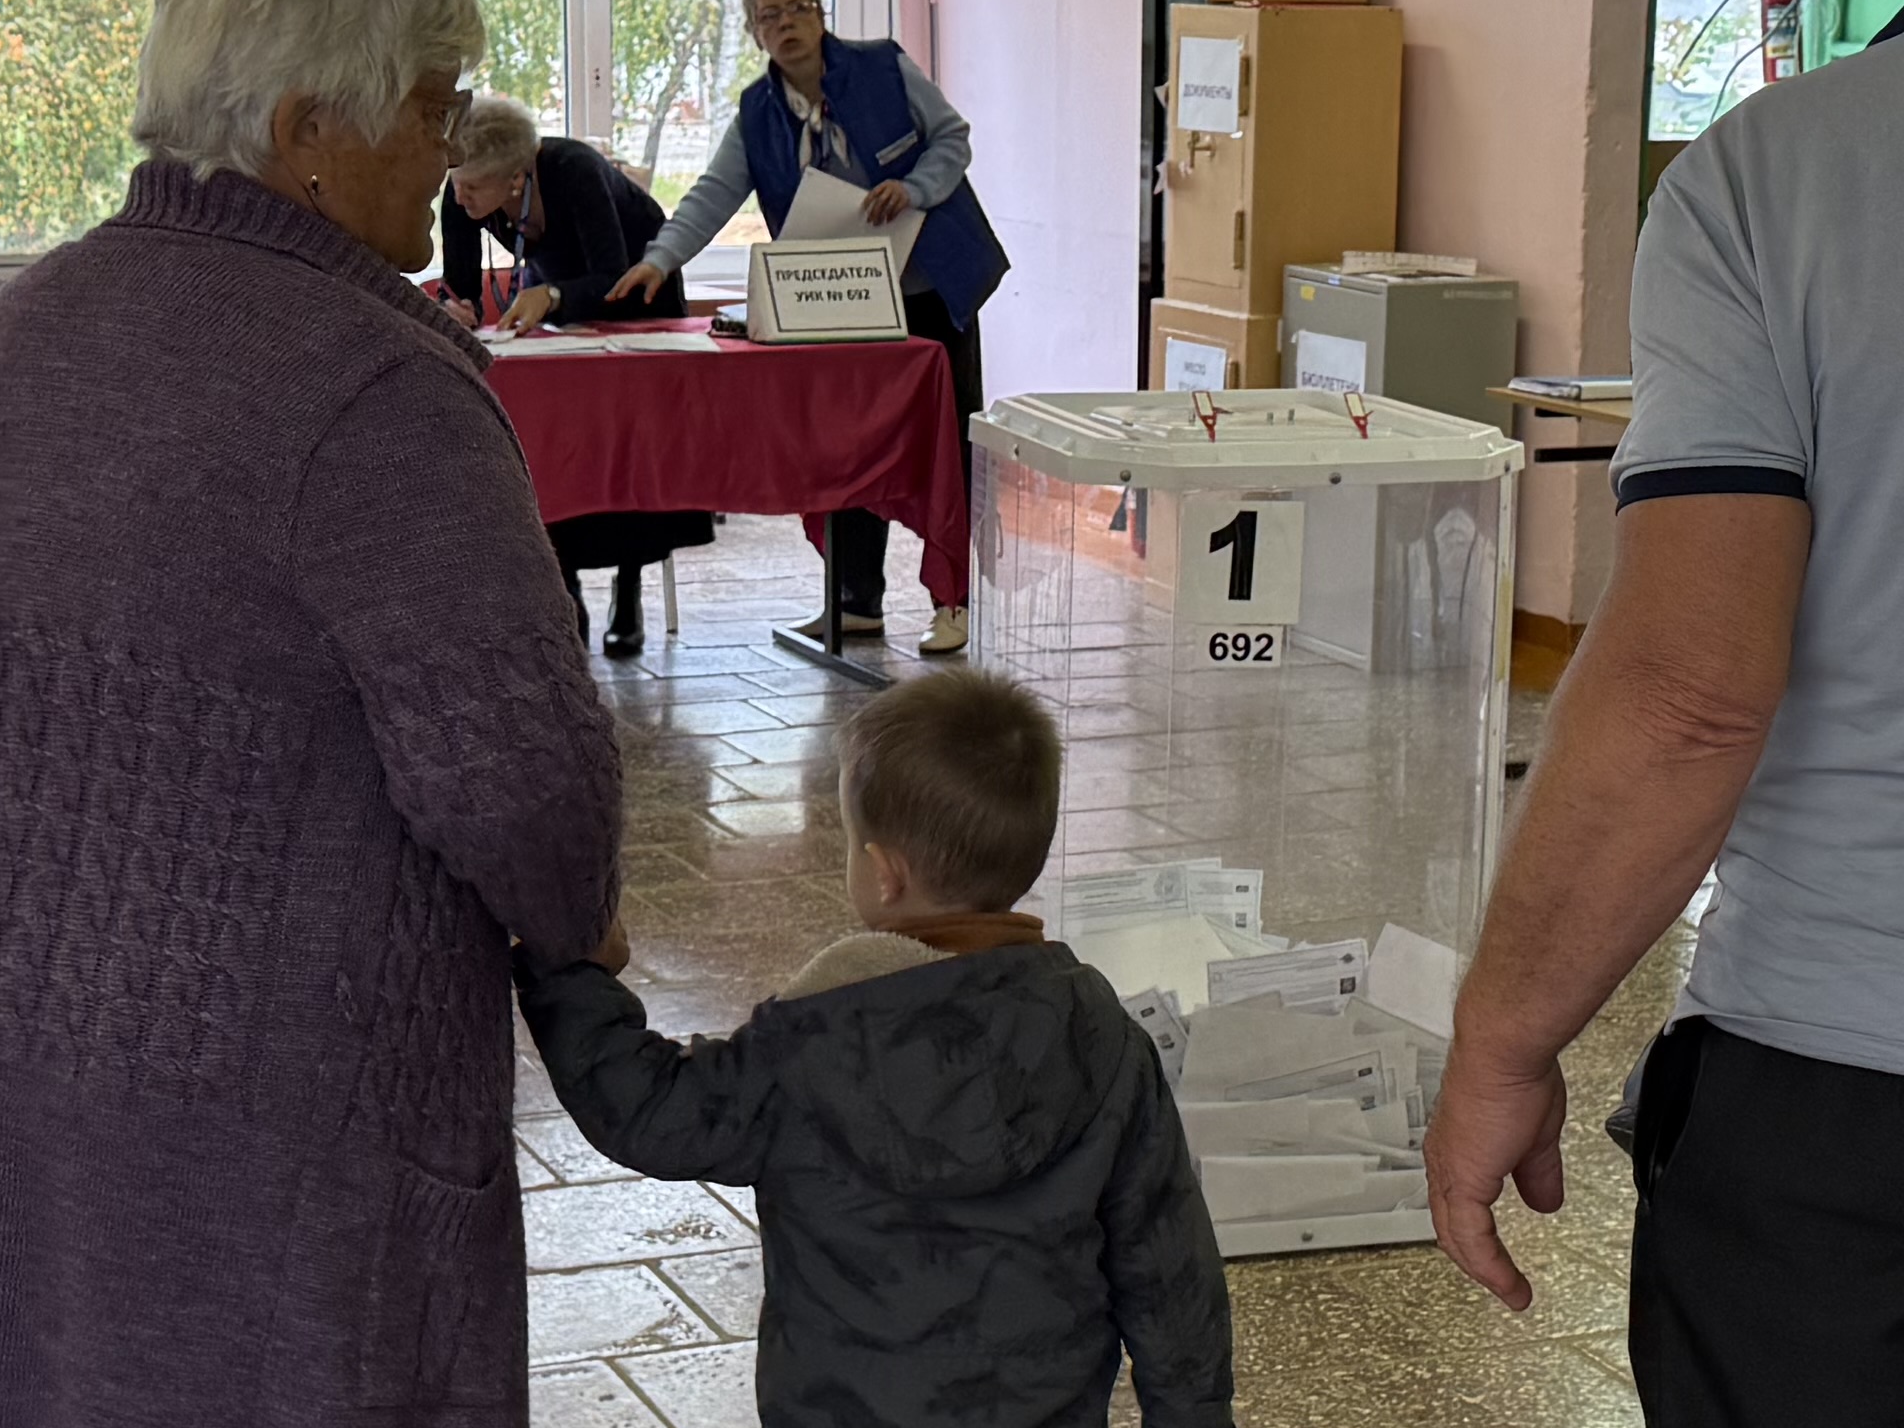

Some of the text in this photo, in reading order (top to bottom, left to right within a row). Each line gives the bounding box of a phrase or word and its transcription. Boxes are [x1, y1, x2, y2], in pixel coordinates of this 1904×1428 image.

[775, 266, 883, 283] ПРЕДСЕДАТЕЛЬ
[795, 289, 823, 303] УИК
[847, 288, 871, 302] 692
[1209, 510, 1259, 602] 1
[1208, 632, 1274, 663] 692
